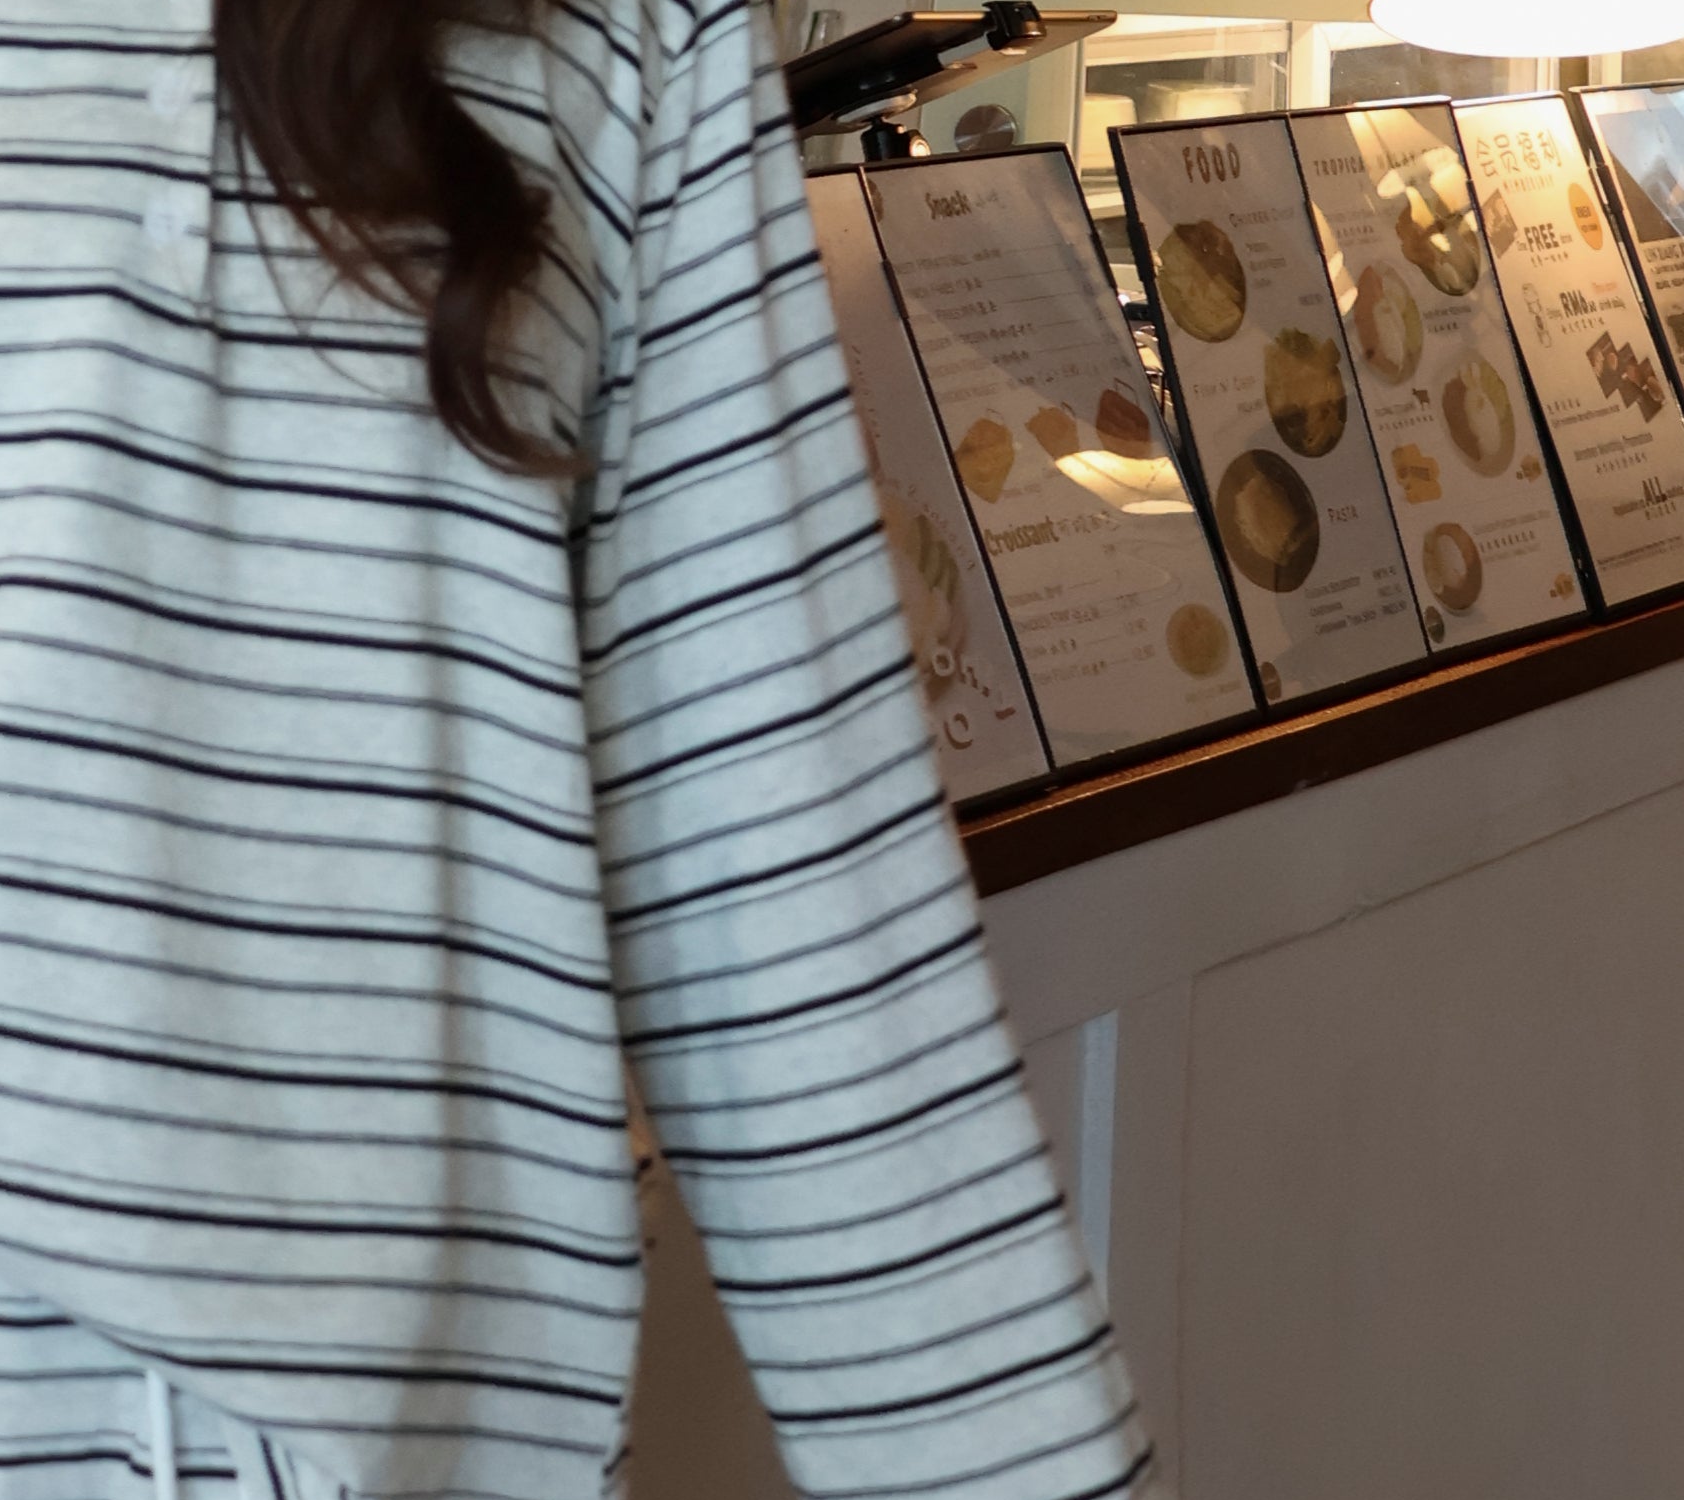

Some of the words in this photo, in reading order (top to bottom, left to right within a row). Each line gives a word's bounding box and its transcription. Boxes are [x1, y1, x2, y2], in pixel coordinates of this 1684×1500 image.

[1182, 143, 1241, 183] FOOD
[1524, 223, 1560, 253] FREE
[984, 516, 1060, 557] Croissant
